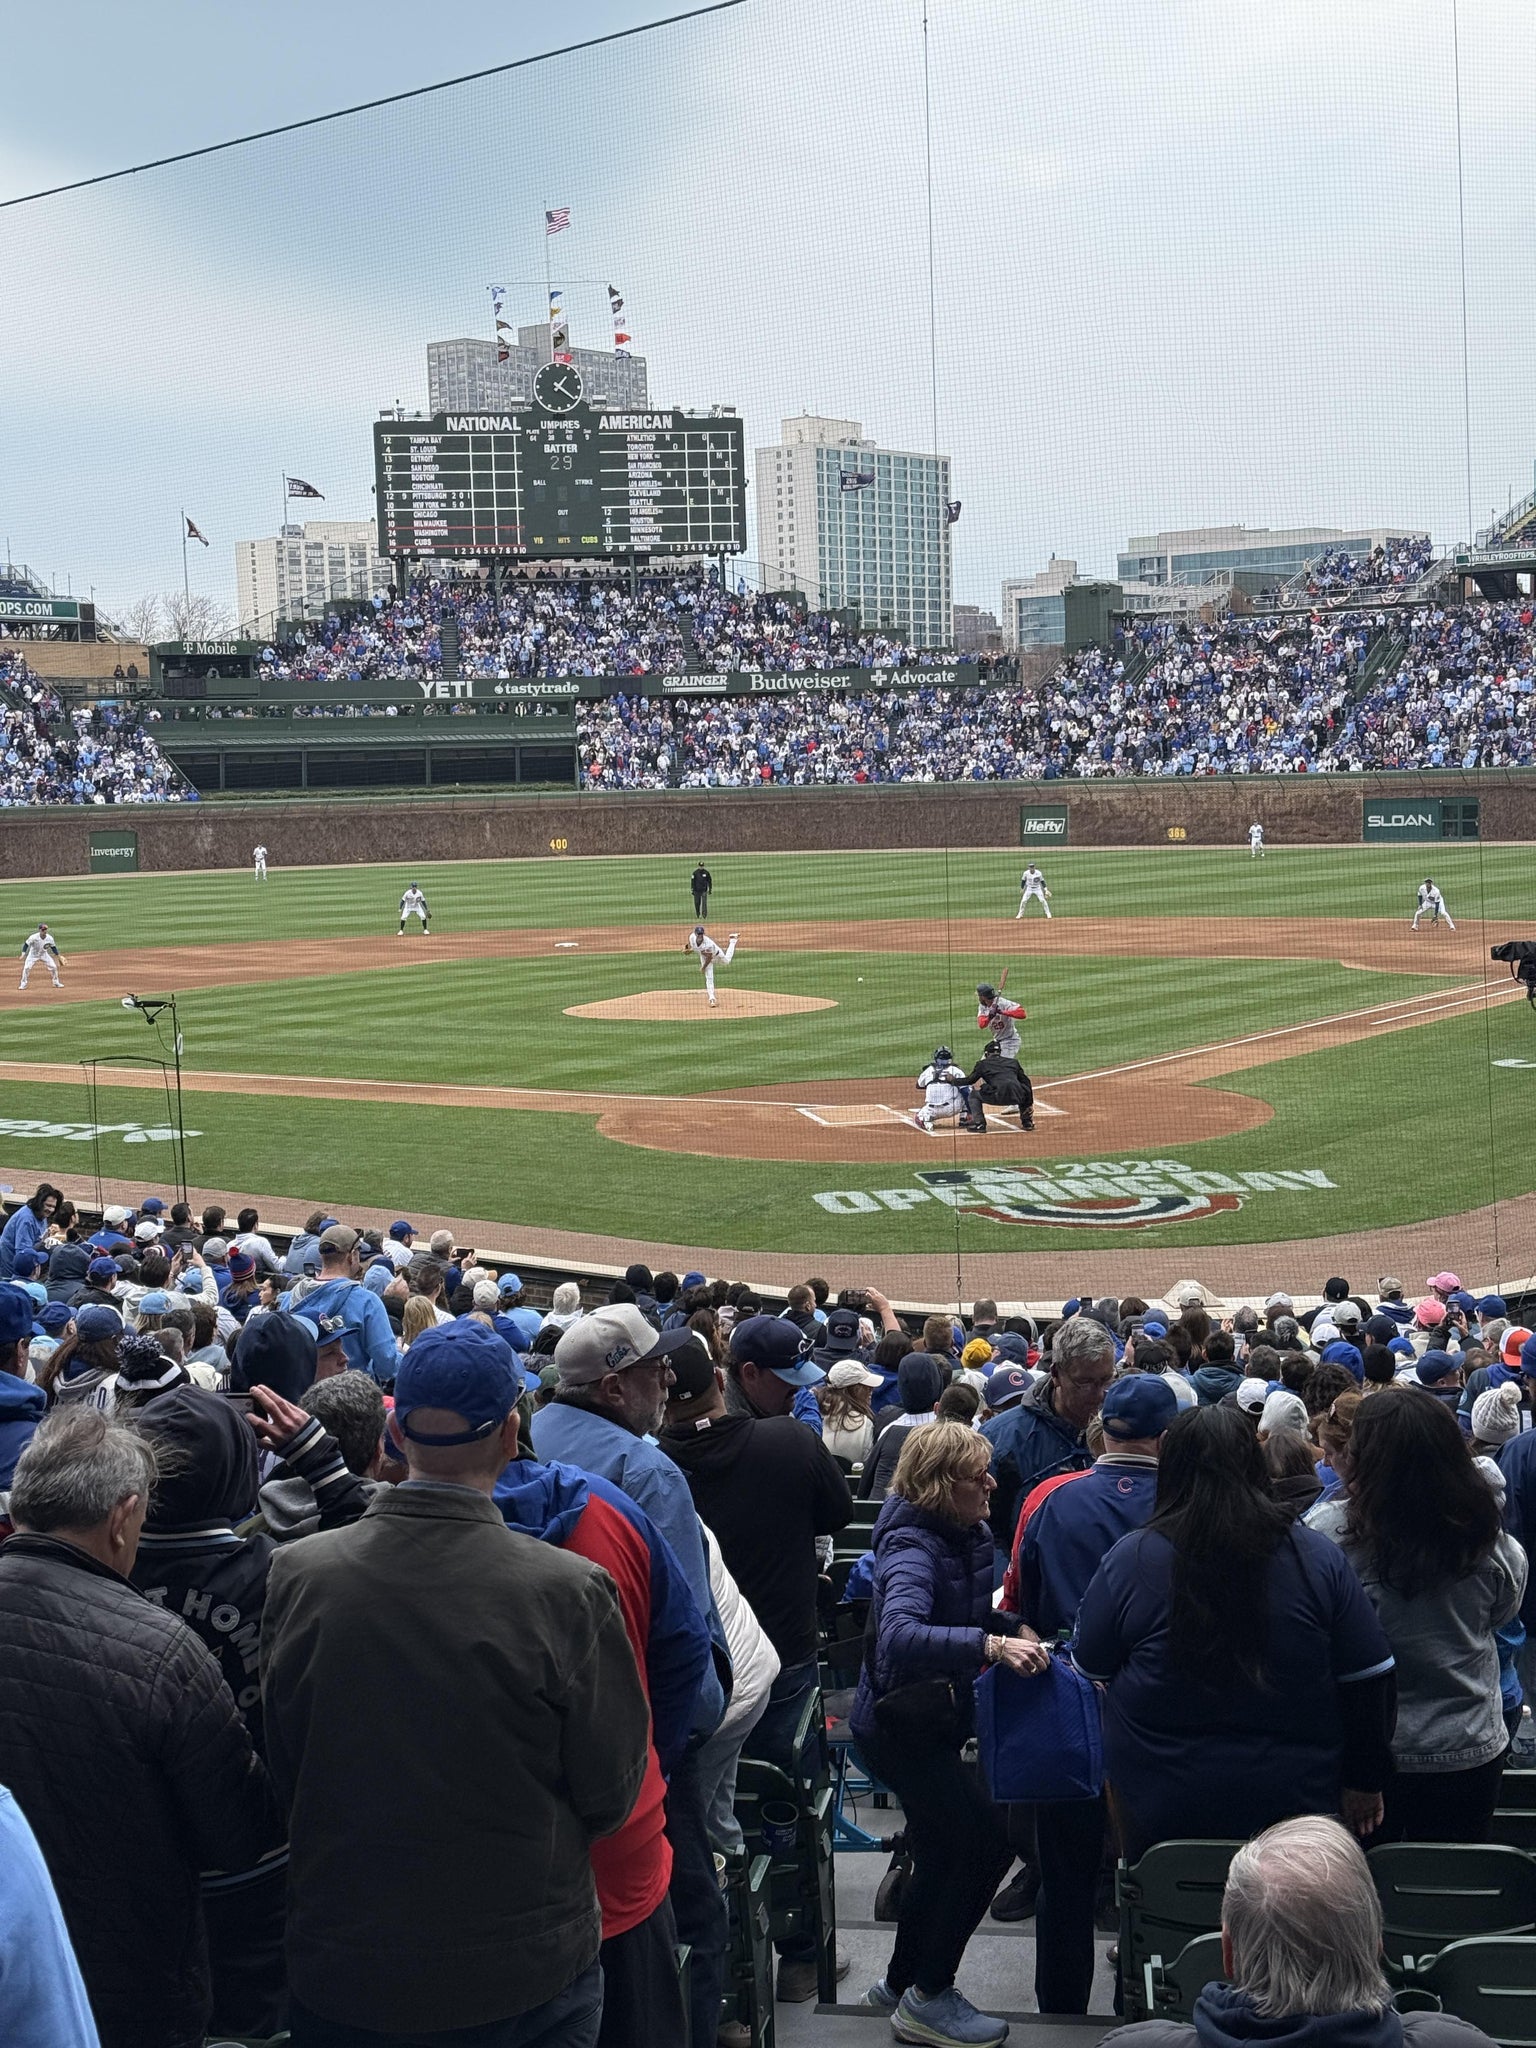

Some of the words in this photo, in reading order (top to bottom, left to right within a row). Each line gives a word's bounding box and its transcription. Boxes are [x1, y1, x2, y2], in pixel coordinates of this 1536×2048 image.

[446, 416, 522, 431] NATIONAL
[540, 420, 580, 429] UMPIRES
[599, 415, 673, 429] AMERICAN
[543, 444, 578, 453] BATTER
[550, 455, 572, 470] 29
[581, 536, 598, 544] CUBS
[0, 601, 53, 616] OPS.COM
[196, 642, 237, 655] Mobile
[662, 675, 728, 687] GRAINGER
[890, 670, 956, 684] Advocate
[418, 681, 474, 698] YETI
[505, 682, 580, 696] tastytrade
[1026, 820, 1062, 833] Hefty
[550, 839, 567, 849] 400
[91, 847, 135, 857] Invenergy
[1055, 1159, 1192, 1177] 2026
[812, 1173, 1184, 1214] OPENING
[1168, 1169, 1341, 1193] DAY
[1118, 1477, 1134, 1493] C
